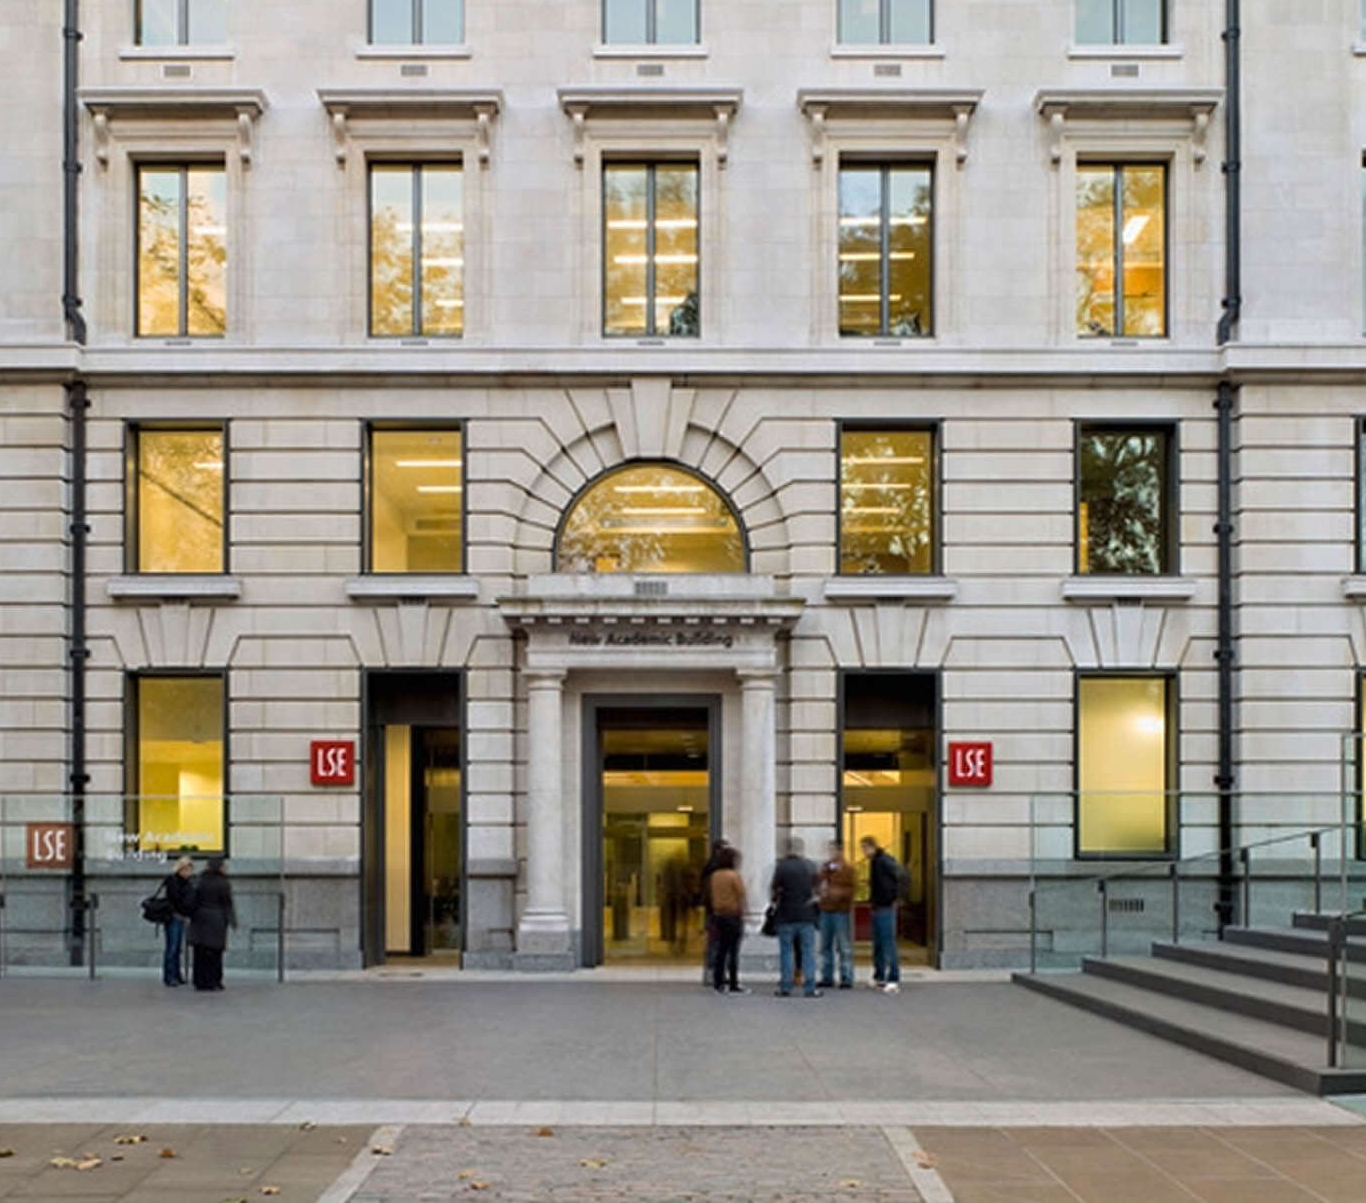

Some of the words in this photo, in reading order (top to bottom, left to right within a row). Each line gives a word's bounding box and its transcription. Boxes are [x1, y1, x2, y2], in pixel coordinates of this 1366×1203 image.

[569, 631, 602, 645] New
[605, 631, 673, 645] Academic
[675, 631, 733, 648] Building
[317, 747, 347, 776] LSE
[955, 747, 986, 777] LSE
[34, 828, 67, 862] LSE
